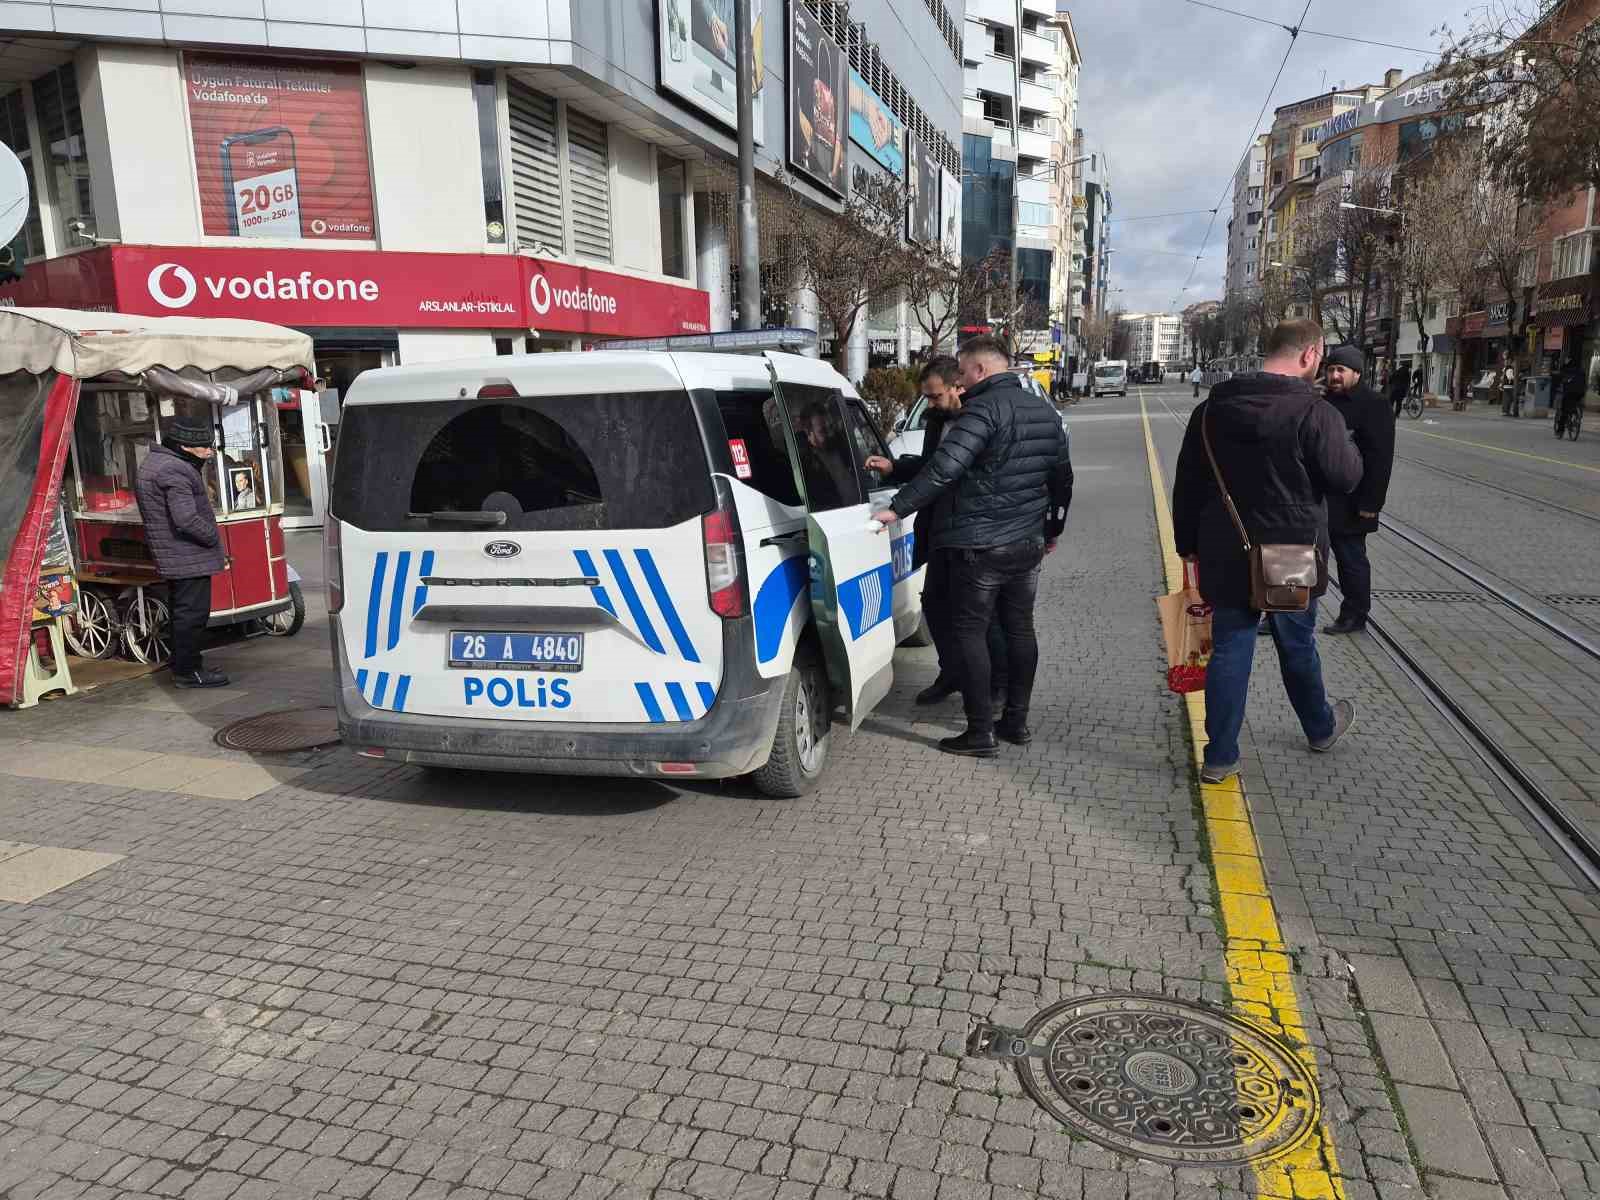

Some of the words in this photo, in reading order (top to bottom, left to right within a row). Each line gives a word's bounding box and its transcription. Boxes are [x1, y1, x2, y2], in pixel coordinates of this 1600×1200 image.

[192, 74, 233, 88] Uygun
[235, 76, 282, 90] Faturalı
[193, 89, 268, 105] Vodafone'da
[240, 185, 270, 215] 20
[272, 184, 294, 203] GB
[242, 215, 262, 228] 1000
[271, 209, 287, 220] 250
[328, 223, 370, 233] vodafone
[205, 271, 379, 301] vodafone
[553, 287, 616, 314] vodafone
[731, 444, 746, 462] 112
[490, 543, 513, 555] Ford
[463, 636, 486, 659] 26
[503, 636, 513, 660] A
[531, 637, 579, 660] 4840
